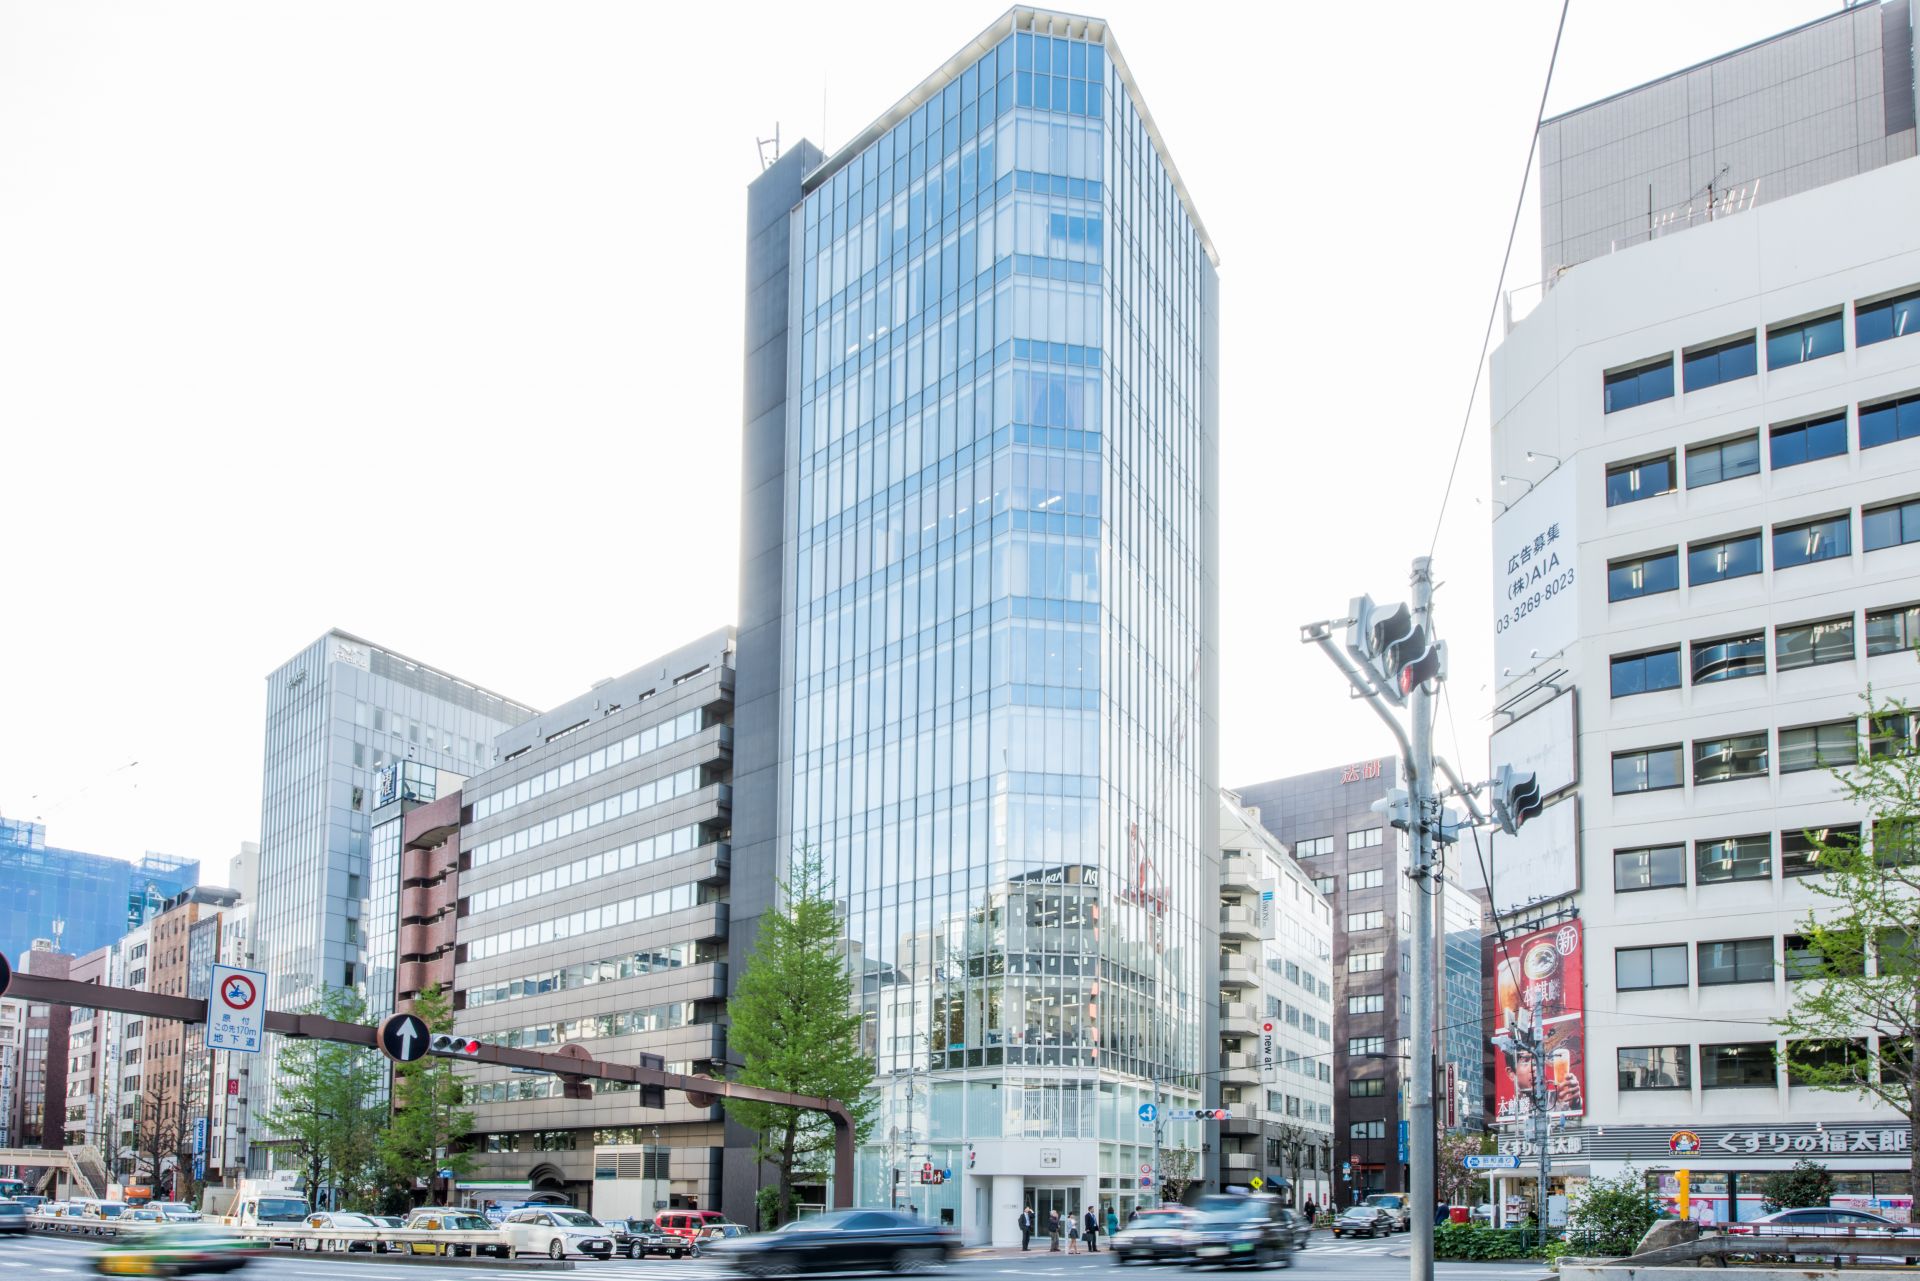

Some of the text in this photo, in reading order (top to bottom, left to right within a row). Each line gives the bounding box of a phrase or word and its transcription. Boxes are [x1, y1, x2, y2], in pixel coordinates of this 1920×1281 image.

[1508, 522, 1560, 575] 広告募集
[1496, 568, 1575, 634] 03-3269-8023
[1341, 760, 1381, 784] 法研
[1558, 929, 1576, 953] 新
[213, 1033, 255, 1047] 地下道
[1264, 1034, 1273, 1071] new art
[1717, 1130, 1907, 1153] くすりの福太郎
